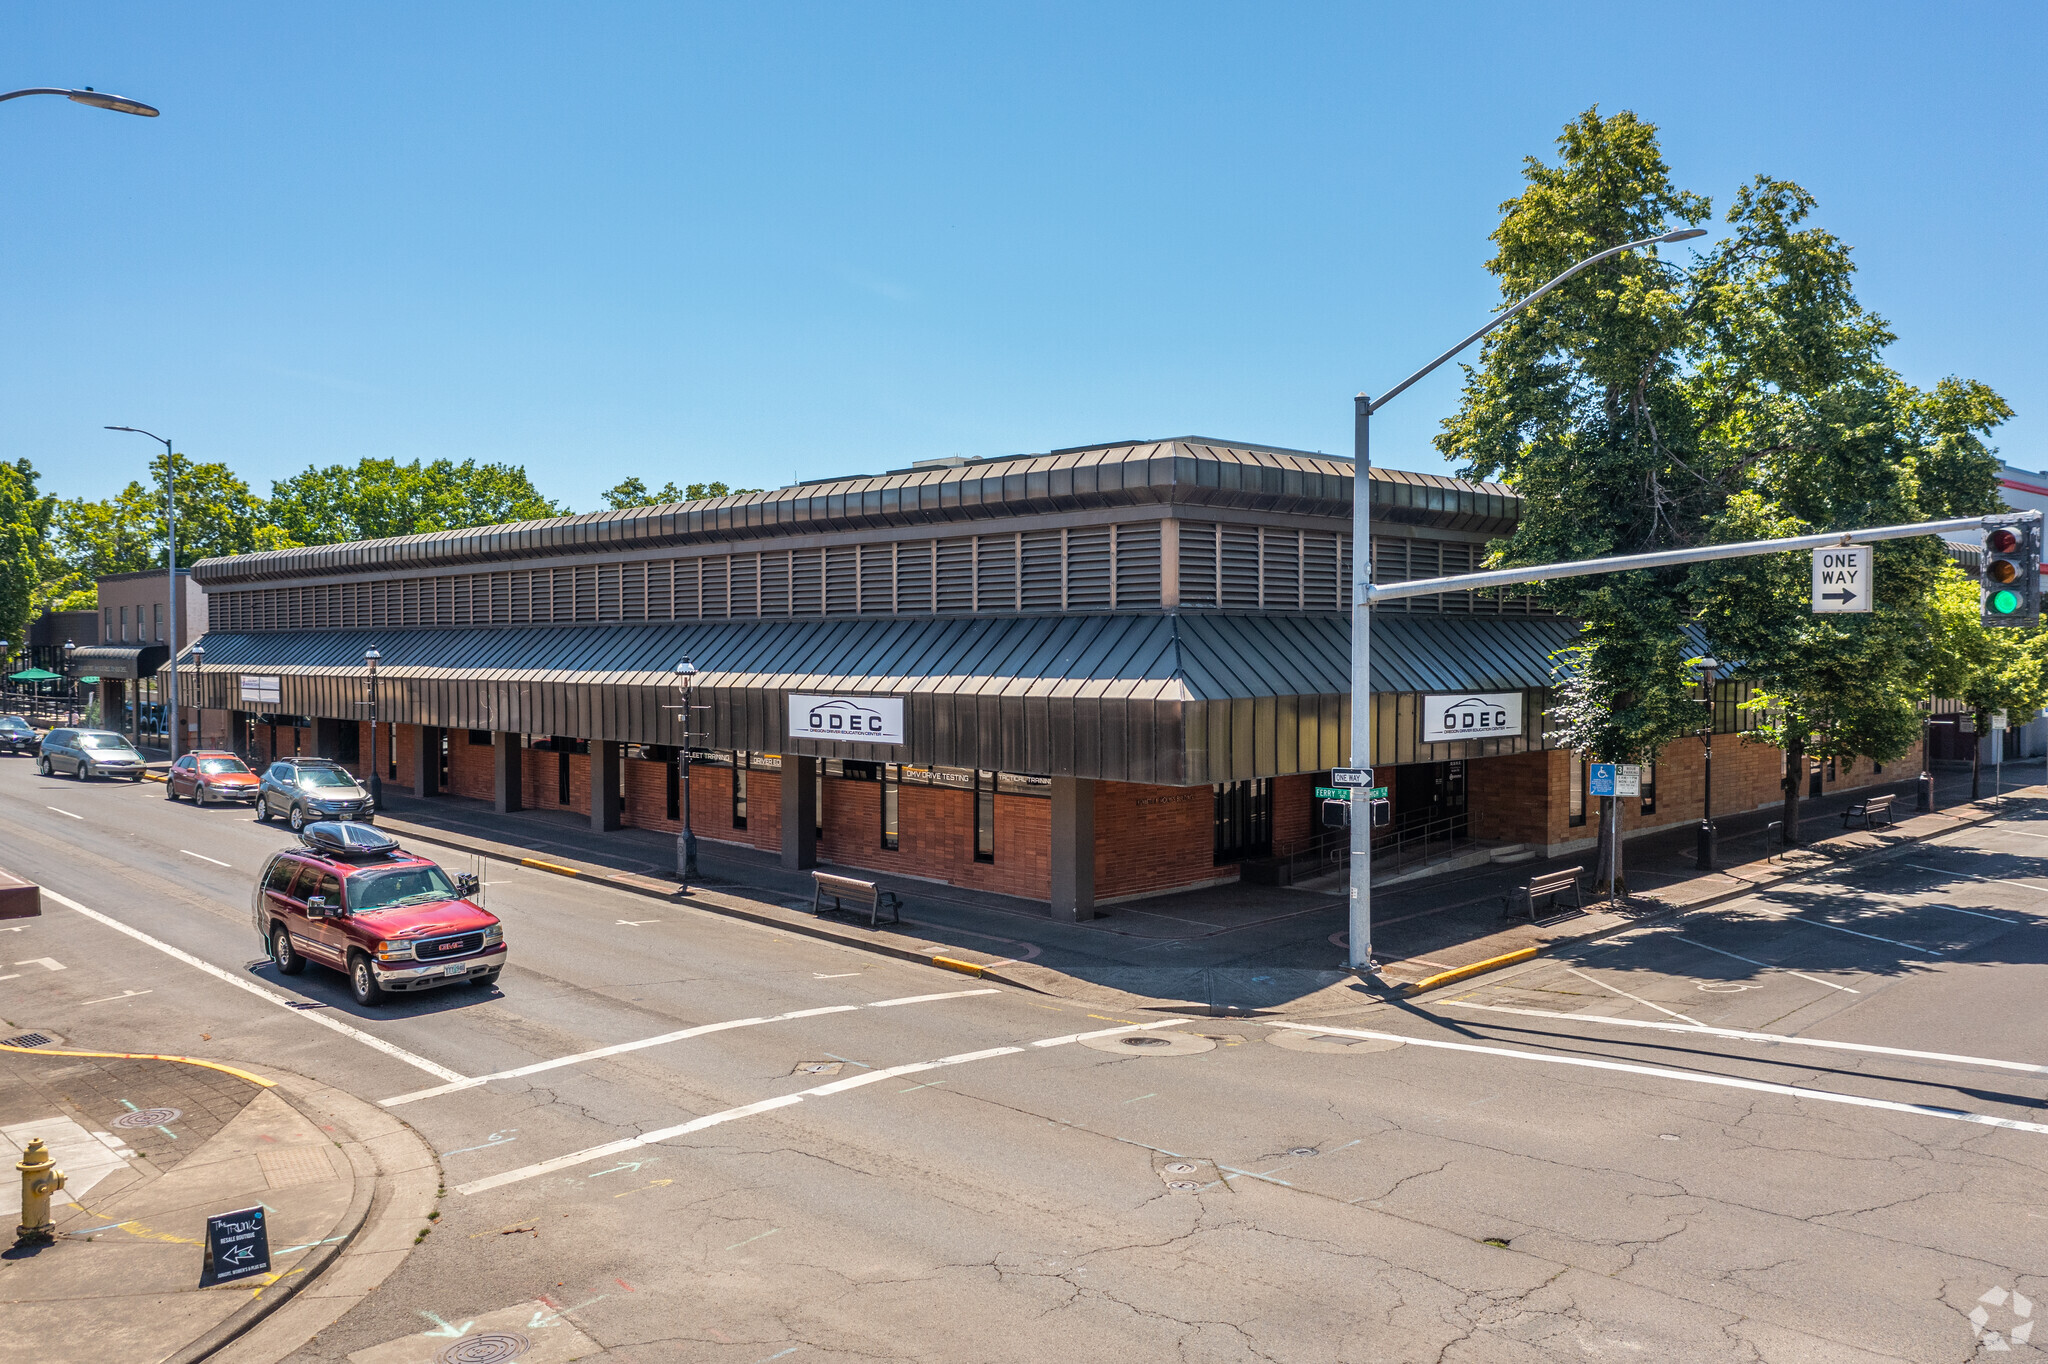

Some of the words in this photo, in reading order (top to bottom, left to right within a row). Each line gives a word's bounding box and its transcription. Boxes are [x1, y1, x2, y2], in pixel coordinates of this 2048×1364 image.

[1823, 554, 1857, 568] ONE
[1822, 570, 1858, 584] WAY
[810, 713, 882, 732] ODEC
[1444, 711, 1506, 729] ODEC
[754, 757, 772, 765] DRIVER
[1617, 766, 1623, 774] 3
[906, 770, 920, 778] DMV
[922, 771, 941, 780] DRIVE
[942, 773, 969, 782] TESTING
[999, 774, 1026, 783] TACTICAL
[1336, 773, 1347, 781] ONE
[1316, 788, 1336, 797] FERRY
[439, 941, 463, 951] GMC
[211, 1220, 226, 1231] The
[220, 1235, 236, 1244] RESALE
[236, 1231, 255, 1241] BOUTIQUE
